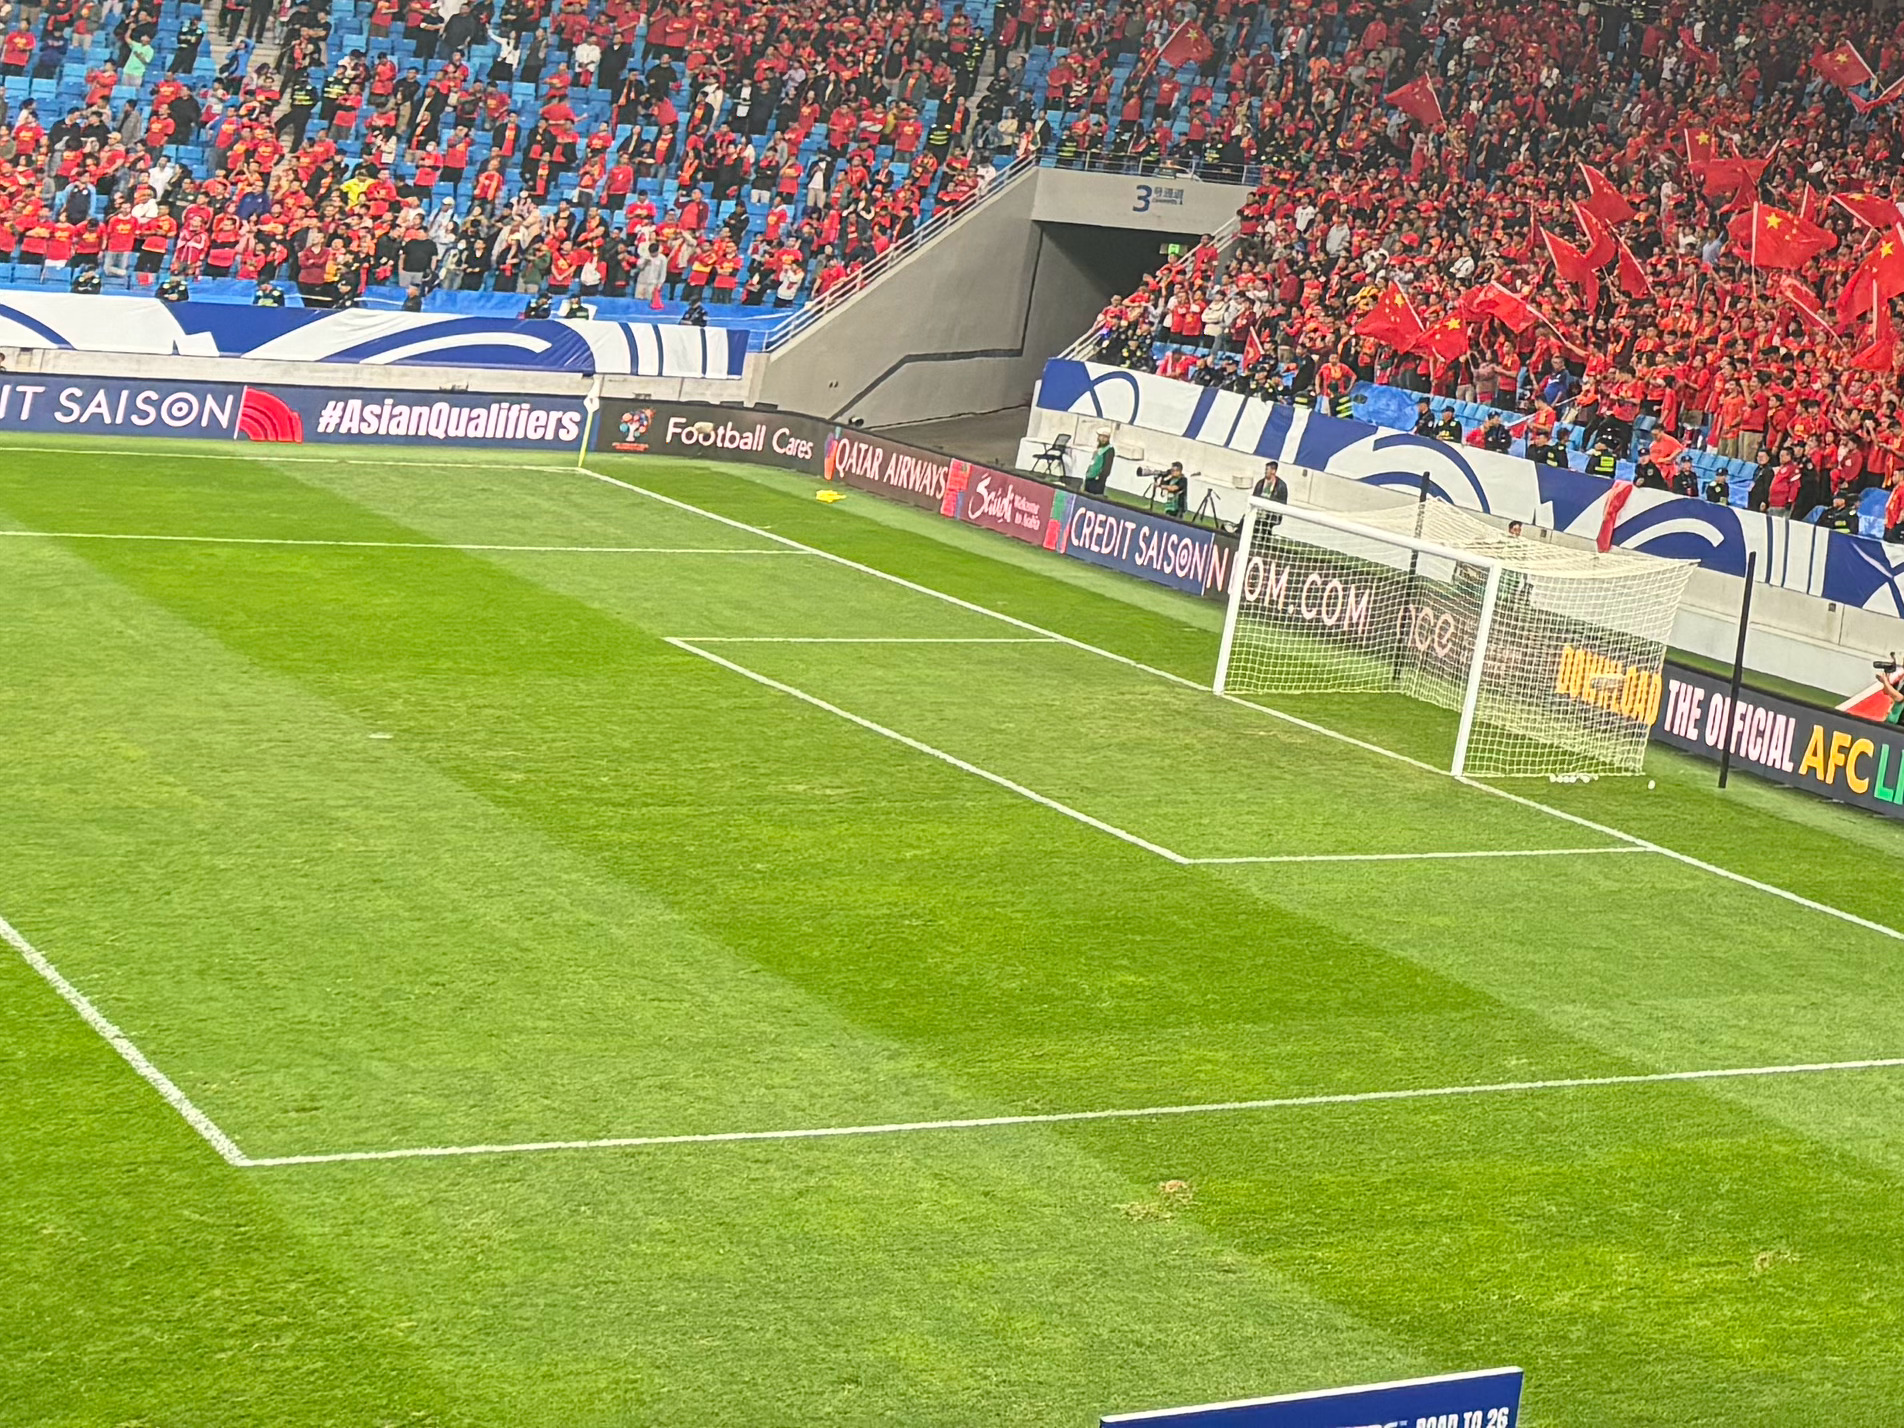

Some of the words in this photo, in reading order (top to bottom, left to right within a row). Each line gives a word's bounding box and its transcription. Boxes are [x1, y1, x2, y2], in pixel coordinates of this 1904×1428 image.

[1132, 184, 1152, 212] 3
[54, 387, 235, 432] SAISON
[317, 398, 581, 443] #AsianQualifiers
[665, 416, 765, 453] Football
[772, 426, 815, 460] Cares
[834, 437, 881, 482] QATAR
[883, 450, 950, 500] AIRWAYS
[1069, 506, 1137, 557] CREDIT
[1135, 523, 1209, 583] SAISON
[1556, 644, 1663, 727] DOWNLOAD
[1664, 678, 1703, 742] THE
[1798, 723, 1876, 794] AFC
[1463, 1410, 1483, 1428] TO
[1486, 1406, 1510, 1428] 26
